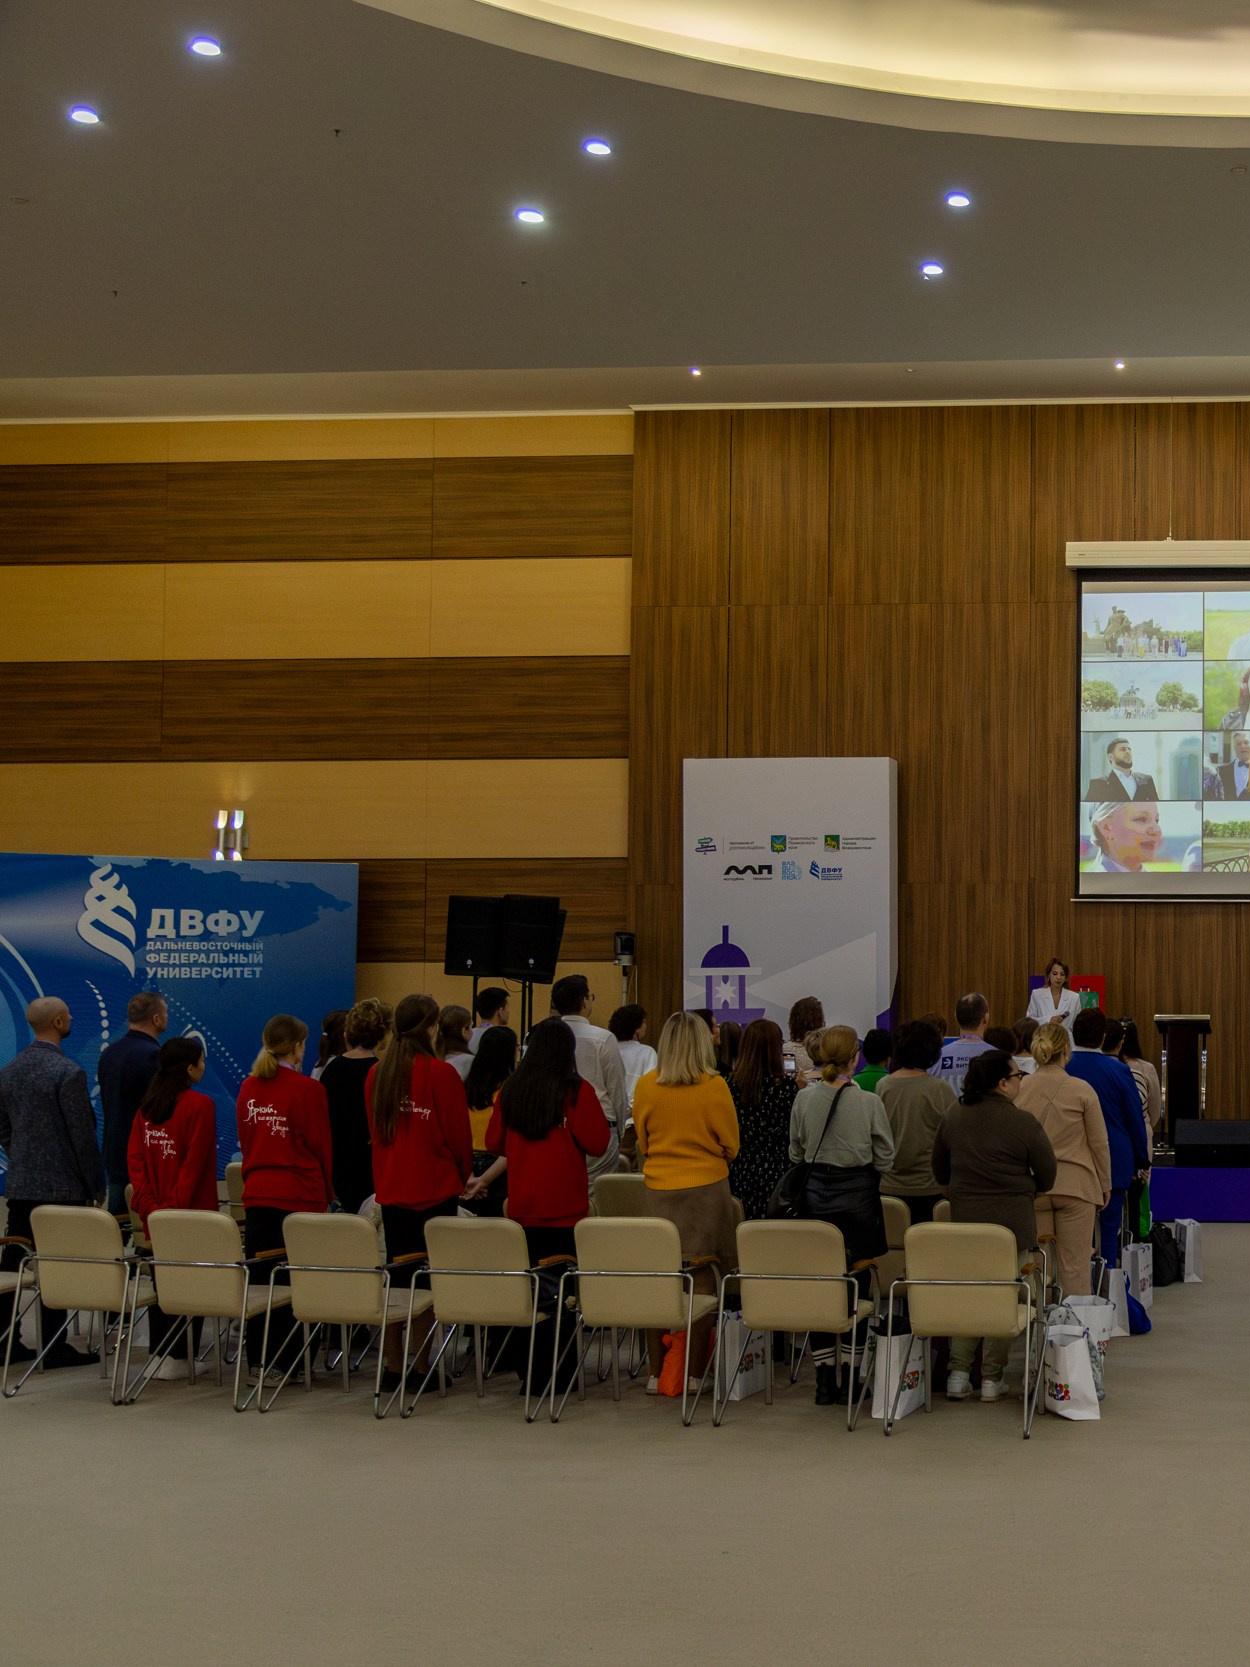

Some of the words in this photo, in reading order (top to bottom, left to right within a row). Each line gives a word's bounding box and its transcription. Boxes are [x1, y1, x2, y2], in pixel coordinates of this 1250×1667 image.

[146, 908, 265, 938] ДВФУ
[146, 940, 264, 951] ДАЛЬНЕВОСТОЧНЫЙ
[146, 951, 264, 964] ФЕДЕРАЛЬНЫЙ
[146, 966, 263, 979] УНИВЕРСИТЕТ
